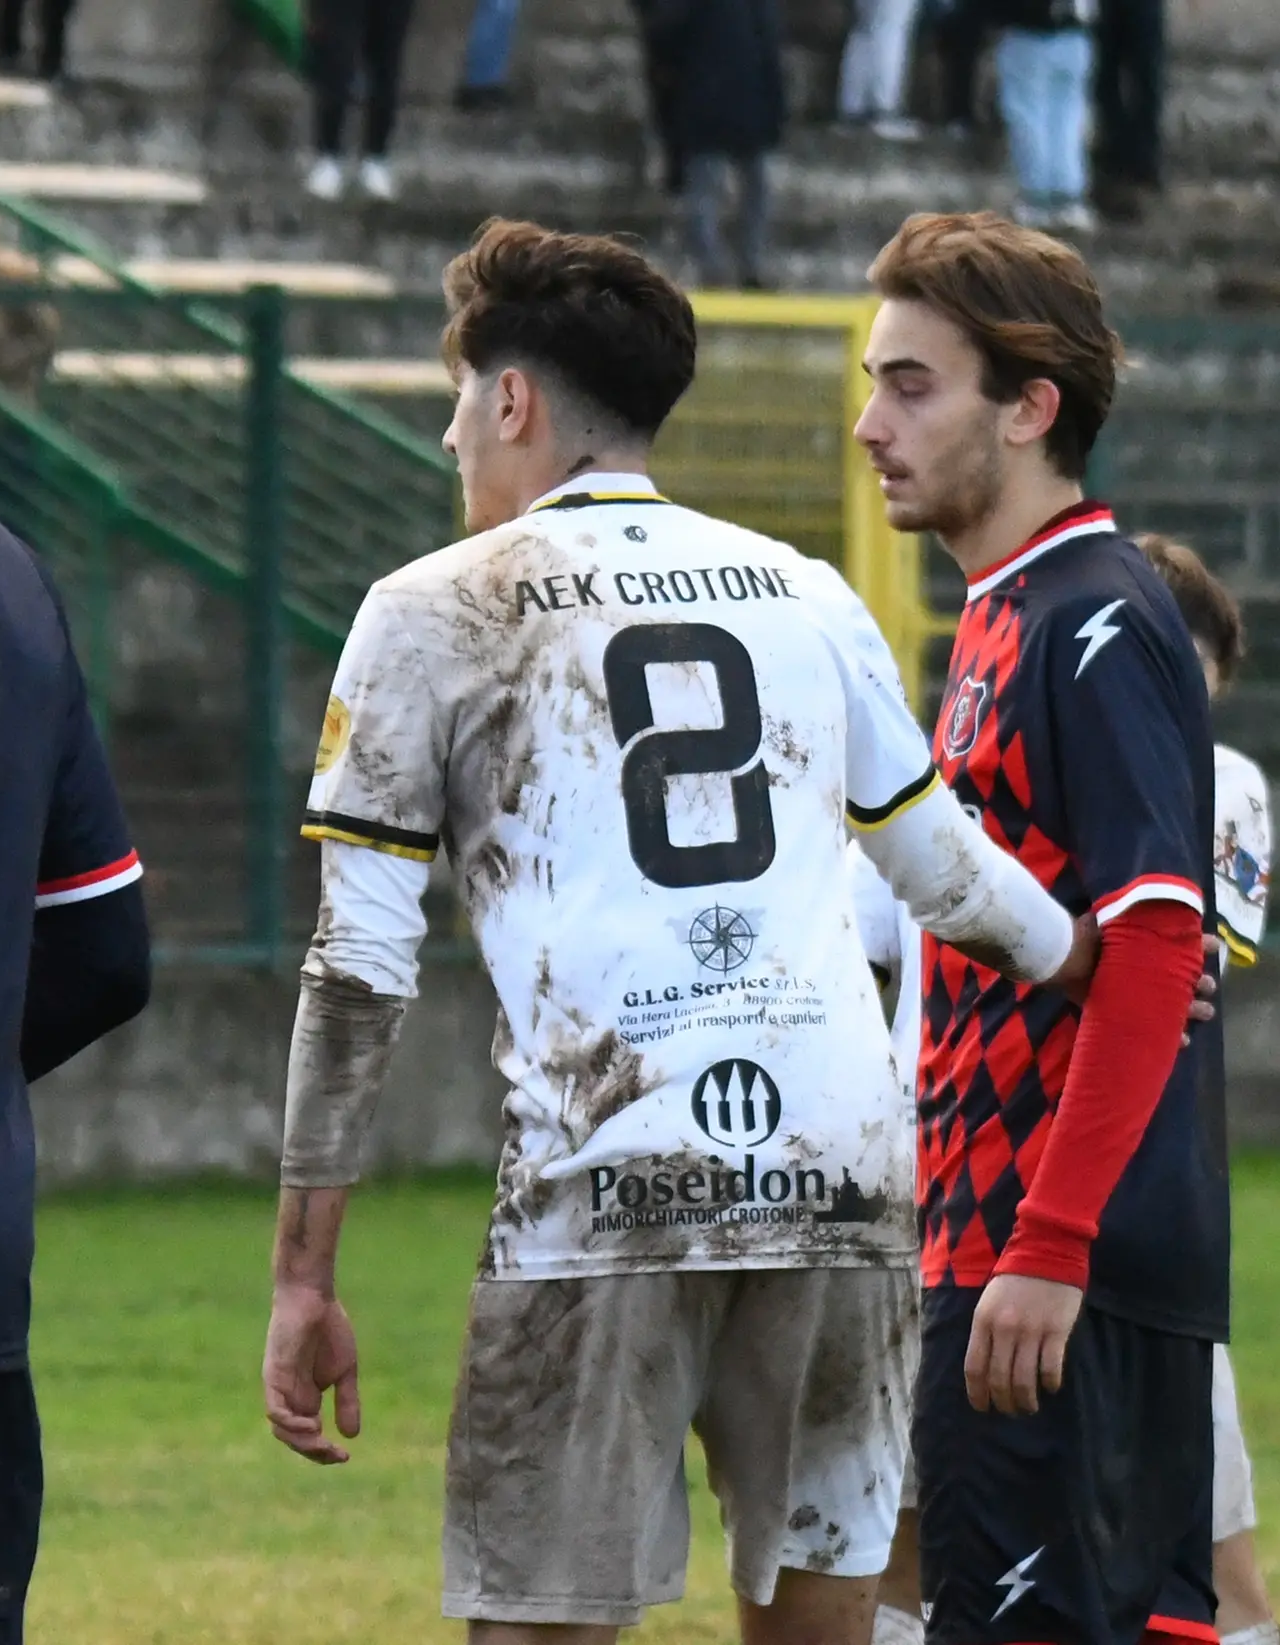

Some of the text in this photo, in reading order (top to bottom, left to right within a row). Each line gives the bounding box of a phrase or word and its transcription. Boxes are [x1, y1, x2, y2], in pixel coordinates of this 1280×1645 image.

[514, 564, 801, 616] AEK CROTONE
[602, 622, 776, 889] 8
[623, 986, 684, 1008] G.L.G.
[690, 976, 770, 998] Service
[620, 1023, 675, 1046] Servizi
[589, 1154, 826, 1212] Poseidon
[592, 1206, 804, 1234] RIMORCHIATORI CROTONE
